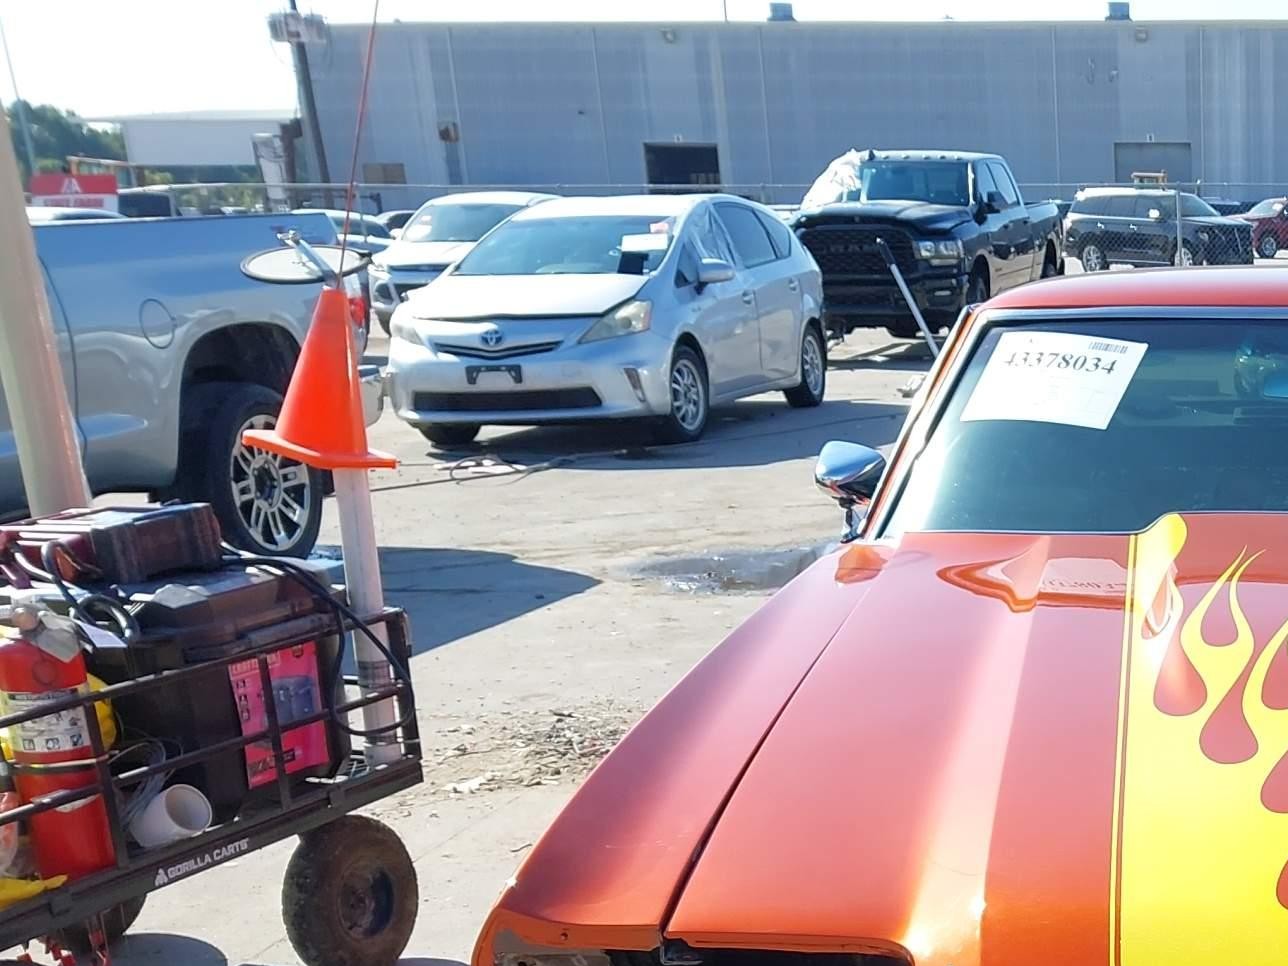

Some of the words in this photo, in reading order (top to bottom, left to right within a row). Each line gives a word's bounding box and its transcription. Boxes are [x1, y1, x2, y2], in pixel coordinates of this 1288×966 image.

[1004, 352, 1117, 375] 43378034
[167, 854, 212, 880] GORILLA
[212, 839, 248, 861] CARTS
